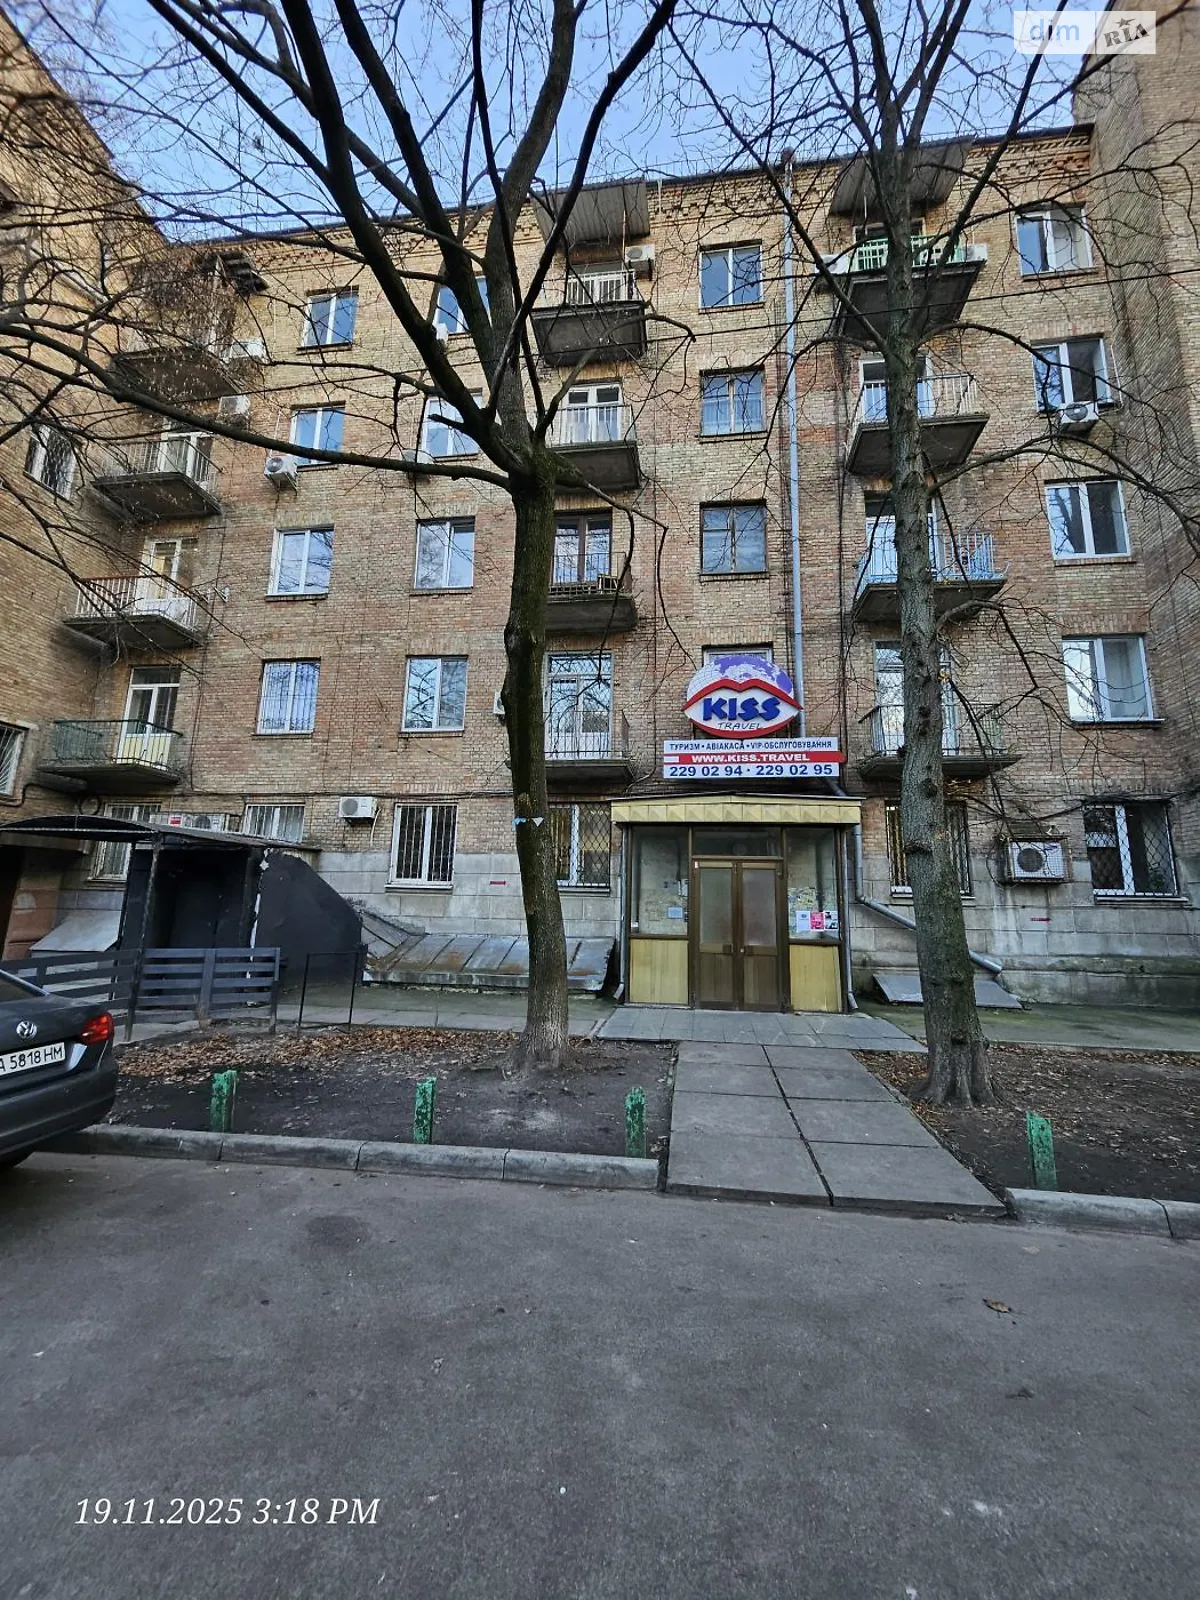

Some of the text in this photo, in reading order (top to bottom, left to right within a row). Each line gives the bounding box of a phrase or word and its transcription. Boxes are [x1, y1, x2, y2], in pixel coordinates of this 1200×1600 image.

[703, 697, 781, 721] KISS
[717, 722, 762, 730] TRAVEL
[669, 743, 700, 751] ТУРИЗМ
[706, 742, 745, 750] АВІАКАСА
[691, 753, 811, 763] WWW.KISS.TRAVEL
[669, 764, 833, 777] 229 02 94 229 02 95
[10, 1050, 41, 1069] 5818
[44, 1046, 63, 1062] HM
